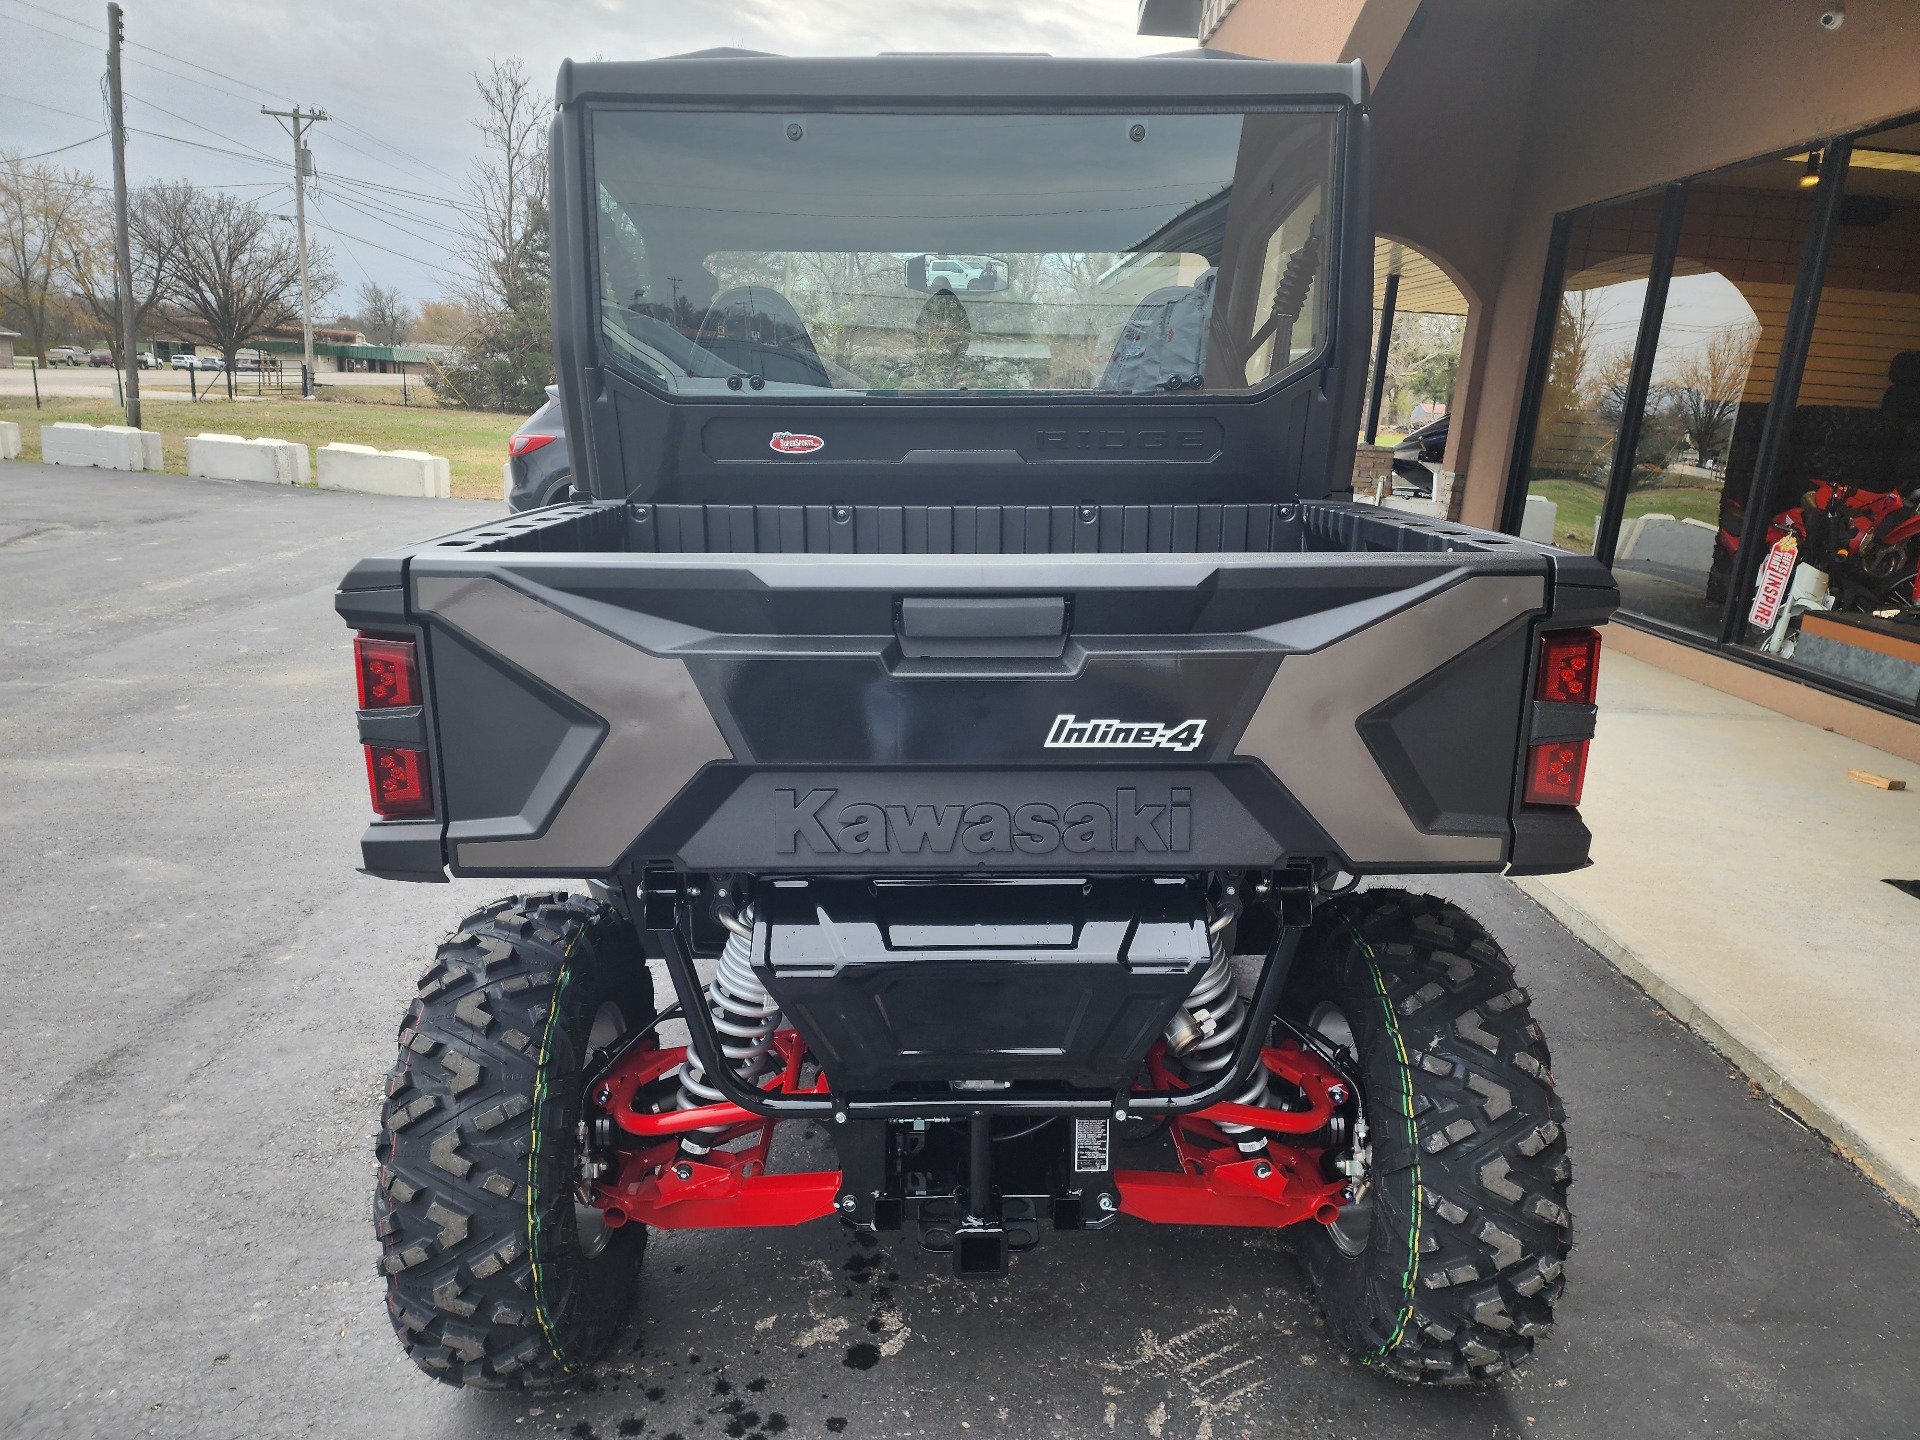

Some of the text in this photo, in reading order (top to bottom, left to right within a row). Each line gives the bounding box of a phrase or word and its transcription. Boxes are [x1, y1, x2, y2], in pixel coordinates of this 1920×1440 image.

[1035, 430, 1204, 450] RIDGE
[1769, 550, 1783, 573] THAT
[1779, 552, 1793, 575] GIFTS
[1754, 573, 1783, 625] INSPIRE
[1043, 714, 1207, 751] Inline-4
[774, 787, 1191, 853] Kawasaki
